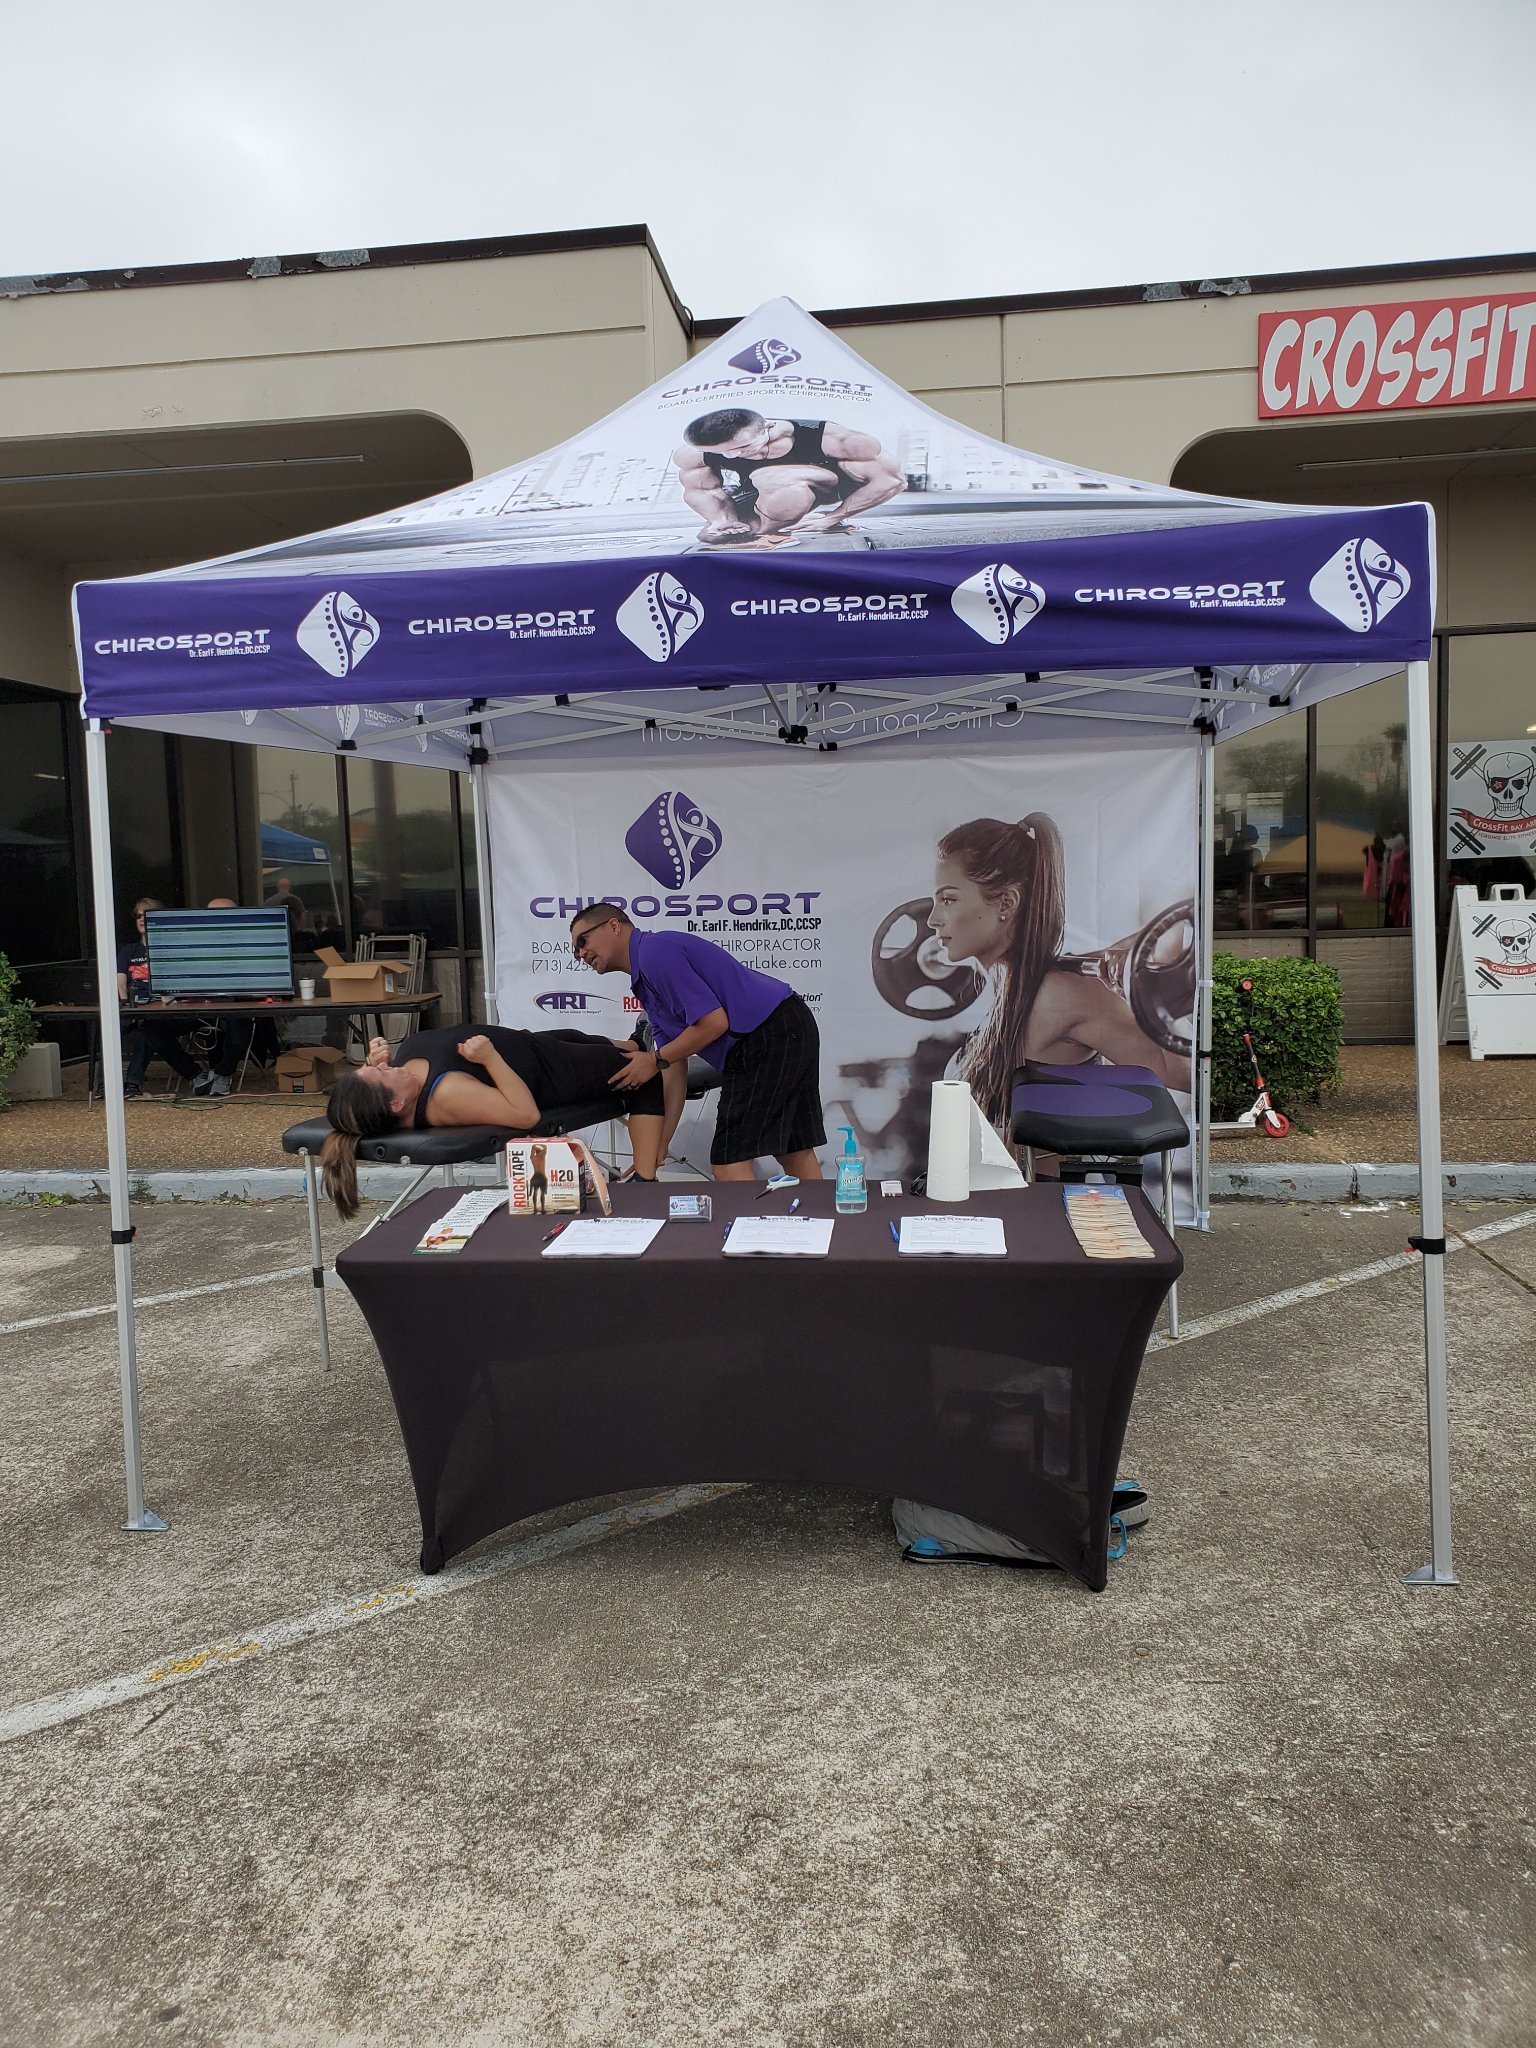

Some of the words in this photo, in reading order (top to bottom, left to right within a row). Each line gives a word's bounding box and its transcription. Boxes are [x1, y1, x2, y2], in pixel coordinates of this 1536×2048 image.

[1262, 302, 1536, 411] CROSSFIT
[661, 375, 873, 398] CHIROSPORT
[788, 390, 871, 402] CHIROPRACTOR
[1074, 580, 1285, 603] CHIROSPORT
[730, 593, 928, 616] CHIROSPORT
[1189, 599, 1200, 608] Dr.
[1201, 599, 1215, 608] Earl
[408, 609, 595, 635] CHIROSPORT
[837, 612, 847, 622] Dr.
[848, 612, 861, 621] Earl
[94, 629, 270, 654] CHIROSPORT
[509, 630, 519, 639] Dr.
[520, 629, 532, 639] Earl
[189, 649, 199, 658] Dr.
[200, 648, 210, 657] Earl
[1473, 818, 1509, 832] CrossFit
[687, 919, 702, 932] Dr.
[702, 919, 721, 932] Earl
[722, 919, 732, 931] F.
[532, 959, 562, 975] (713)
[565, 959, 596, 972] 425-
[512, 1150, 527, 1208] ROCKTAPE
